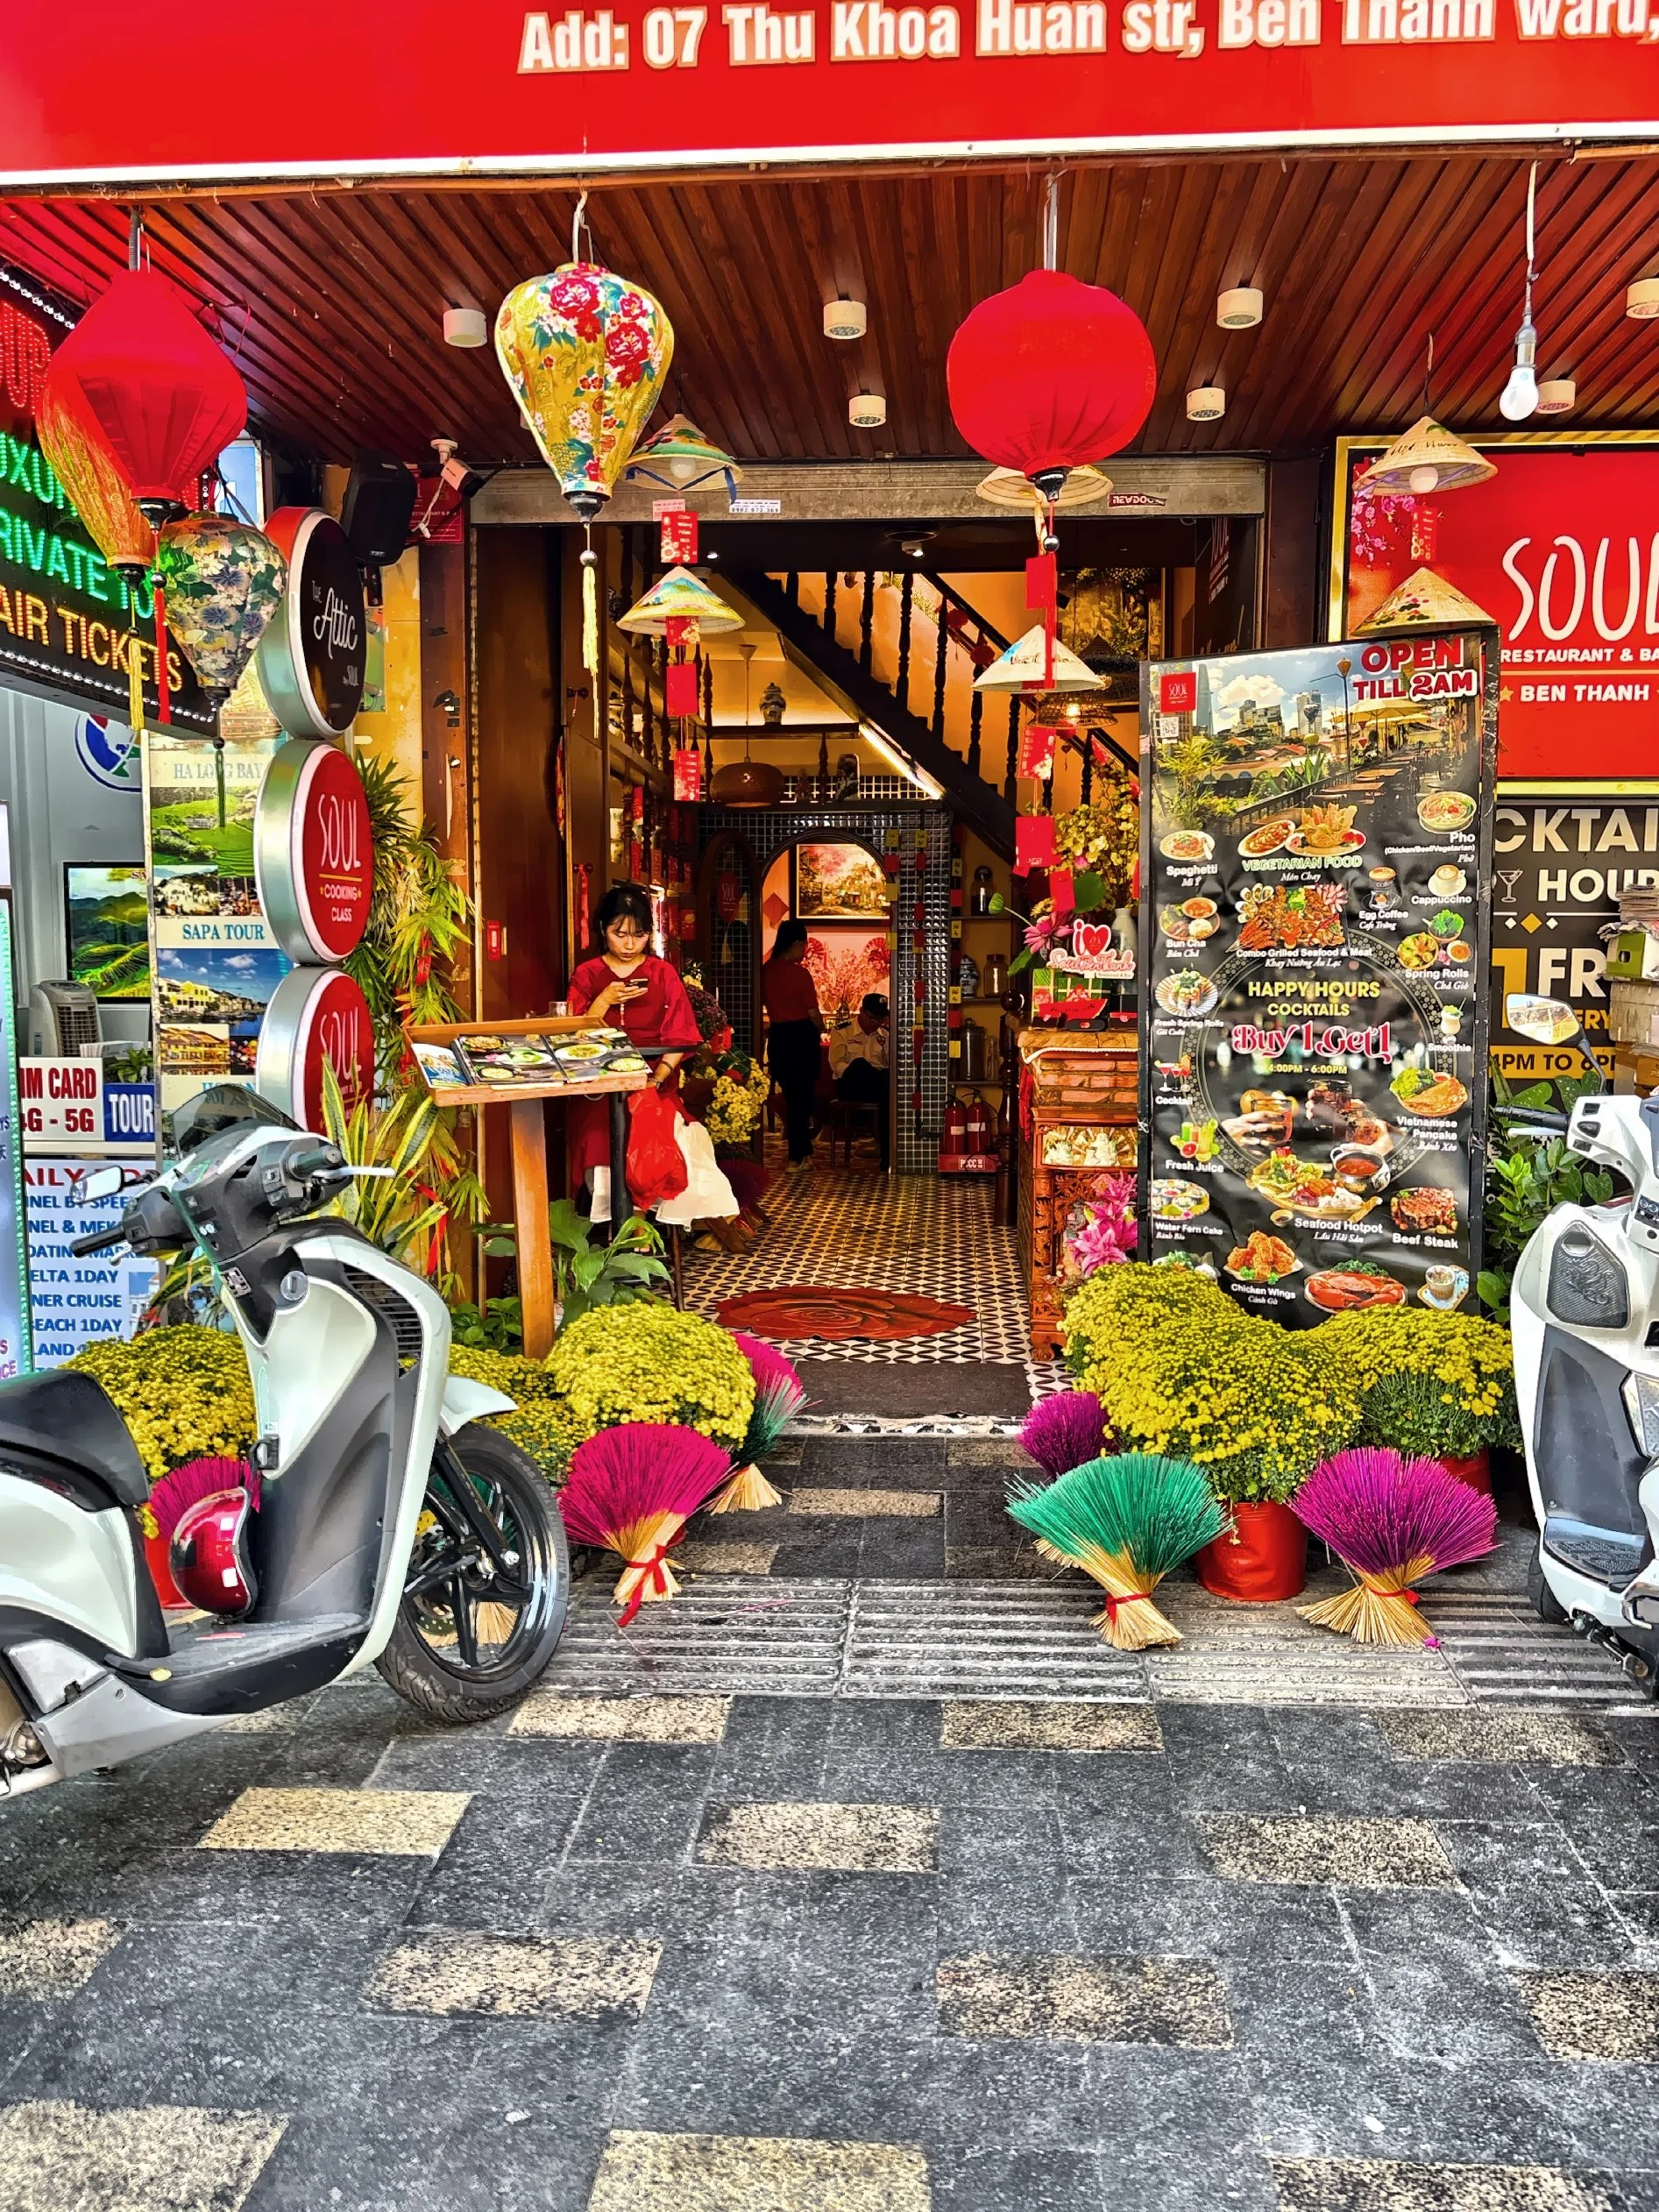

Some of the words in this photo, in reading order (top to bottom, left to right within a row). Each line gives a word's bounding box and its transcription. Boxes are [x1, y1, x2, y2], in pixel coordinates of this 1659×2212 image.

[520, 11, 628, 71] Add:
[644, 7, 705, 67] 07
[724, 4, 814, 64] Thu
[832, 1, 958, 58] Khoa
[978, 0, 1104, 53] Huan
[1124, 0, 1204, 56] str,
[1220, 0, 1318, 46] Ben
[313, 586, 358, 661] Attic
[1360, 635, 1464, 676] OPEN
[1500, 648, 1615, 663] RESTAURANT
[1620, 648, 1634, 663] &
[1352, 677, 1409, 701] TILL
[1408, 669, 1478, 702] 2AM
[1520, 684, 1566, 702] BEN
[1573, 684, 1650, 701] THANH
[174, 762, 194, 780] HA
[236, 762, 263, 779] BAY
[317, 792, 362, 872] SOUL
[1450, 832, 1476, 843] Pho
[1166, 864, 1218, 877] Spaghetti
[1241, 857, 1322, 872] VEGETARIAN
[1323, 854, 1364, 869] FOOD
[323, 883, 358, 901] COOKING
[1410, 895, 1473, 906] Cappuccino
[331, 906, 353, 923] CLASS
[1358, 910, 1377, 921] Egg
[1378, 910, 1409, 919] Coffee
[181, 923, 221, 941] SAPA
[224, 923, 266, 940] TOUR
[1165, 939, 1185, 948] Bun
[1186, 939, 1207, 948] Cha
[1235, 948, 1267, 958] Combo
[1267, 947, 1300, 957] Grilled
[1301, 947, 1340, 957] Seafood
[1340, 947, 1349, 957] &
[1349, 946, 1373, 957] Meat
[1404, 968, 1441, 980] Spring
[1442, 968, 1470, 979] Rolls
[1247, 981, 1308, 997] HAPPY
[1315, 981, 1381, 998] HOURS
[1266, 1003, 1351, 1017] COCKTAILS
[1177, 1019, 1203, 1029] Spring
[1231, 1023, 1301, 1059] Buy
[1302, 1019, 1314, 1053] 1
[1427, 1043, 1472, 1053] Smoothie
[1267, 1063, 1303, 1074] 4:00PM
[1310, 1064, 1348, 1074] 6:00PM
[1542, 1054, 1573, 1070] TO
[48, 1067, 97, 1100] CARD
[1155, 1096, 1194, 1105] Cocktail
[65, 1107, 95, 1133] 5G
[109, 1094, 153, 1133] TOUR
[1396, 1116, 1458, 1129] Vietnamese
[1412, 1129, 1458, 1141] Pancake
[1165, 1159, 1195, 1171] Fresh
[1195, 1162, 1224, 1173] Juice
[62, 1219, 76, 1234] &
[1155, 1221, 1181, 1231] Water
[1181, 1223, 1202, 1234] Fern
[1202, 1226, 1223, 1236] Cake
[1294, 1217, 1342, 1231] Seafood
[1343, 1221, 1384, 1235] Hotpot
[1392, 1232, 1421, 1244] Beef
[1423, 1236, 1459, 1249] Steak
[74, 1269, 119, 1284] 1DAY
[1230, 1283, 1266, 1295] Chicken
[1267, 1287, 1297, 1301] Wings
[67, 1293, 123, 1308] CRUISE
[81, 1317, 123, 1332] 1DAY
